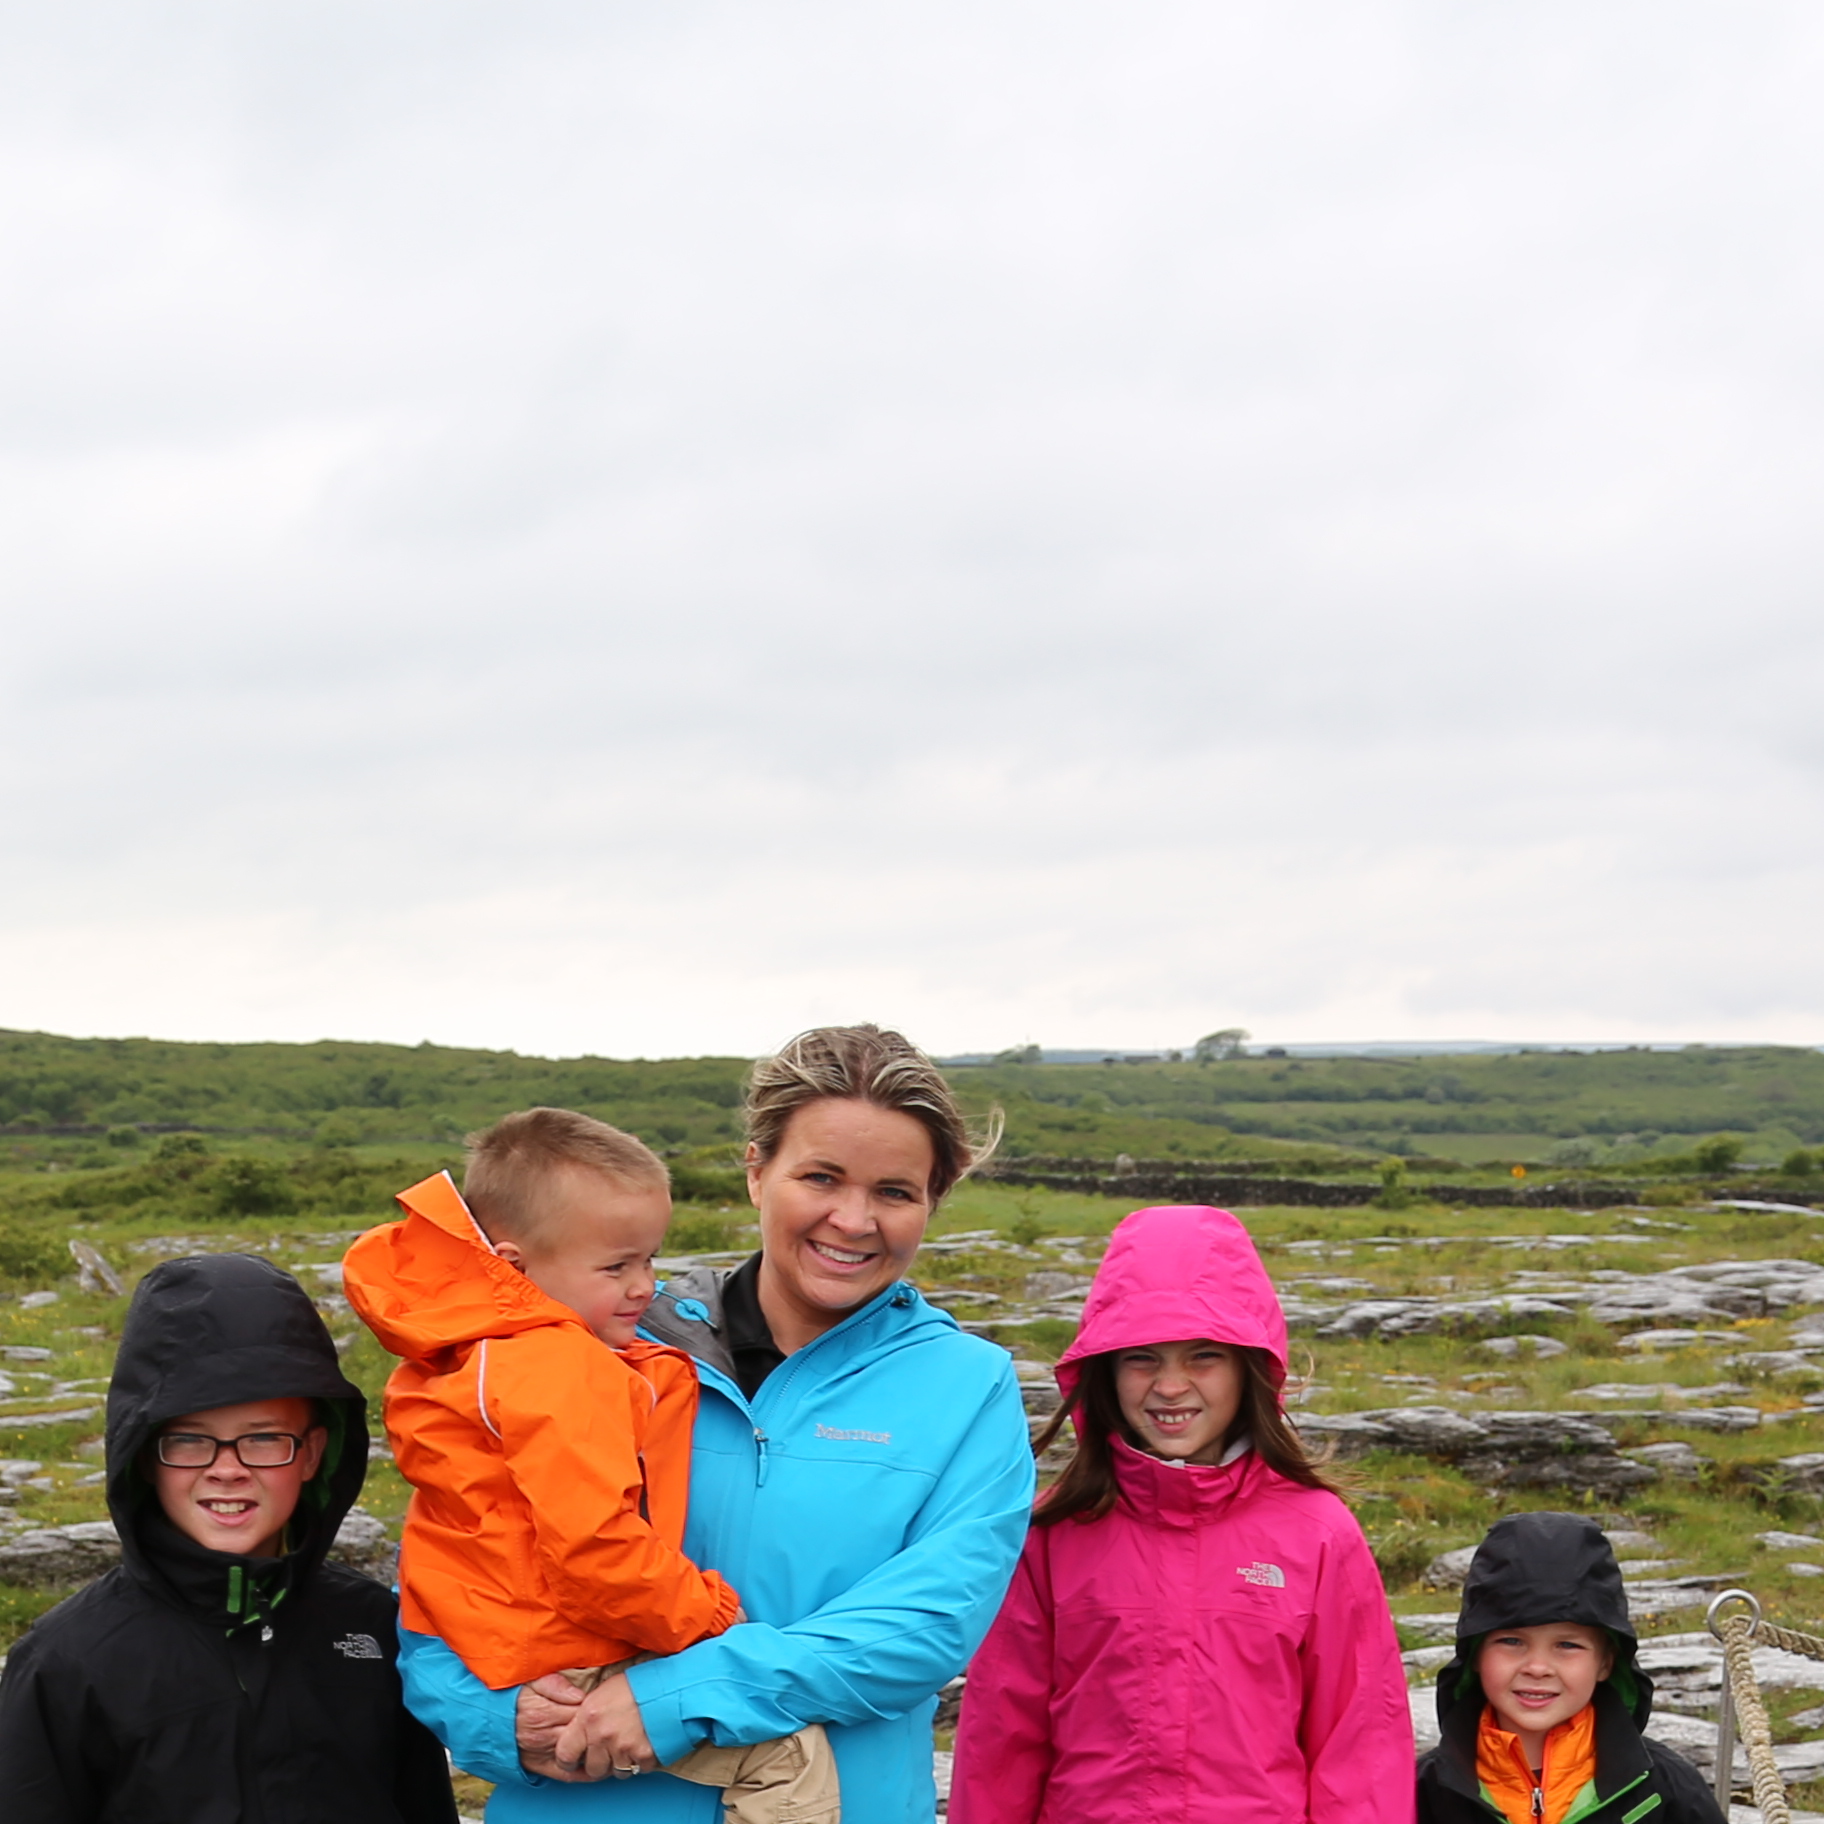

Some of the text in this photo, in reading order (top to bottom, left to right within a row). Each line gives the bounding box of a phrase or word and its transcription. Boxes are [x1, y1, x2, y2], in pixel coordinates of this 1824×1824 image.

[815, 1423, 891, 1445] Marmot
[1252, 1561, 1268, 1571] THE
[1236, 1566, 1266, 1579] NORTH
[1245, 1575, 1269, 1586] FACE
[346, 1633, 364, 1642] THE
[333, 1641, 365, 1650] NORTH
[344, 1649, 367, 1658] FACE
